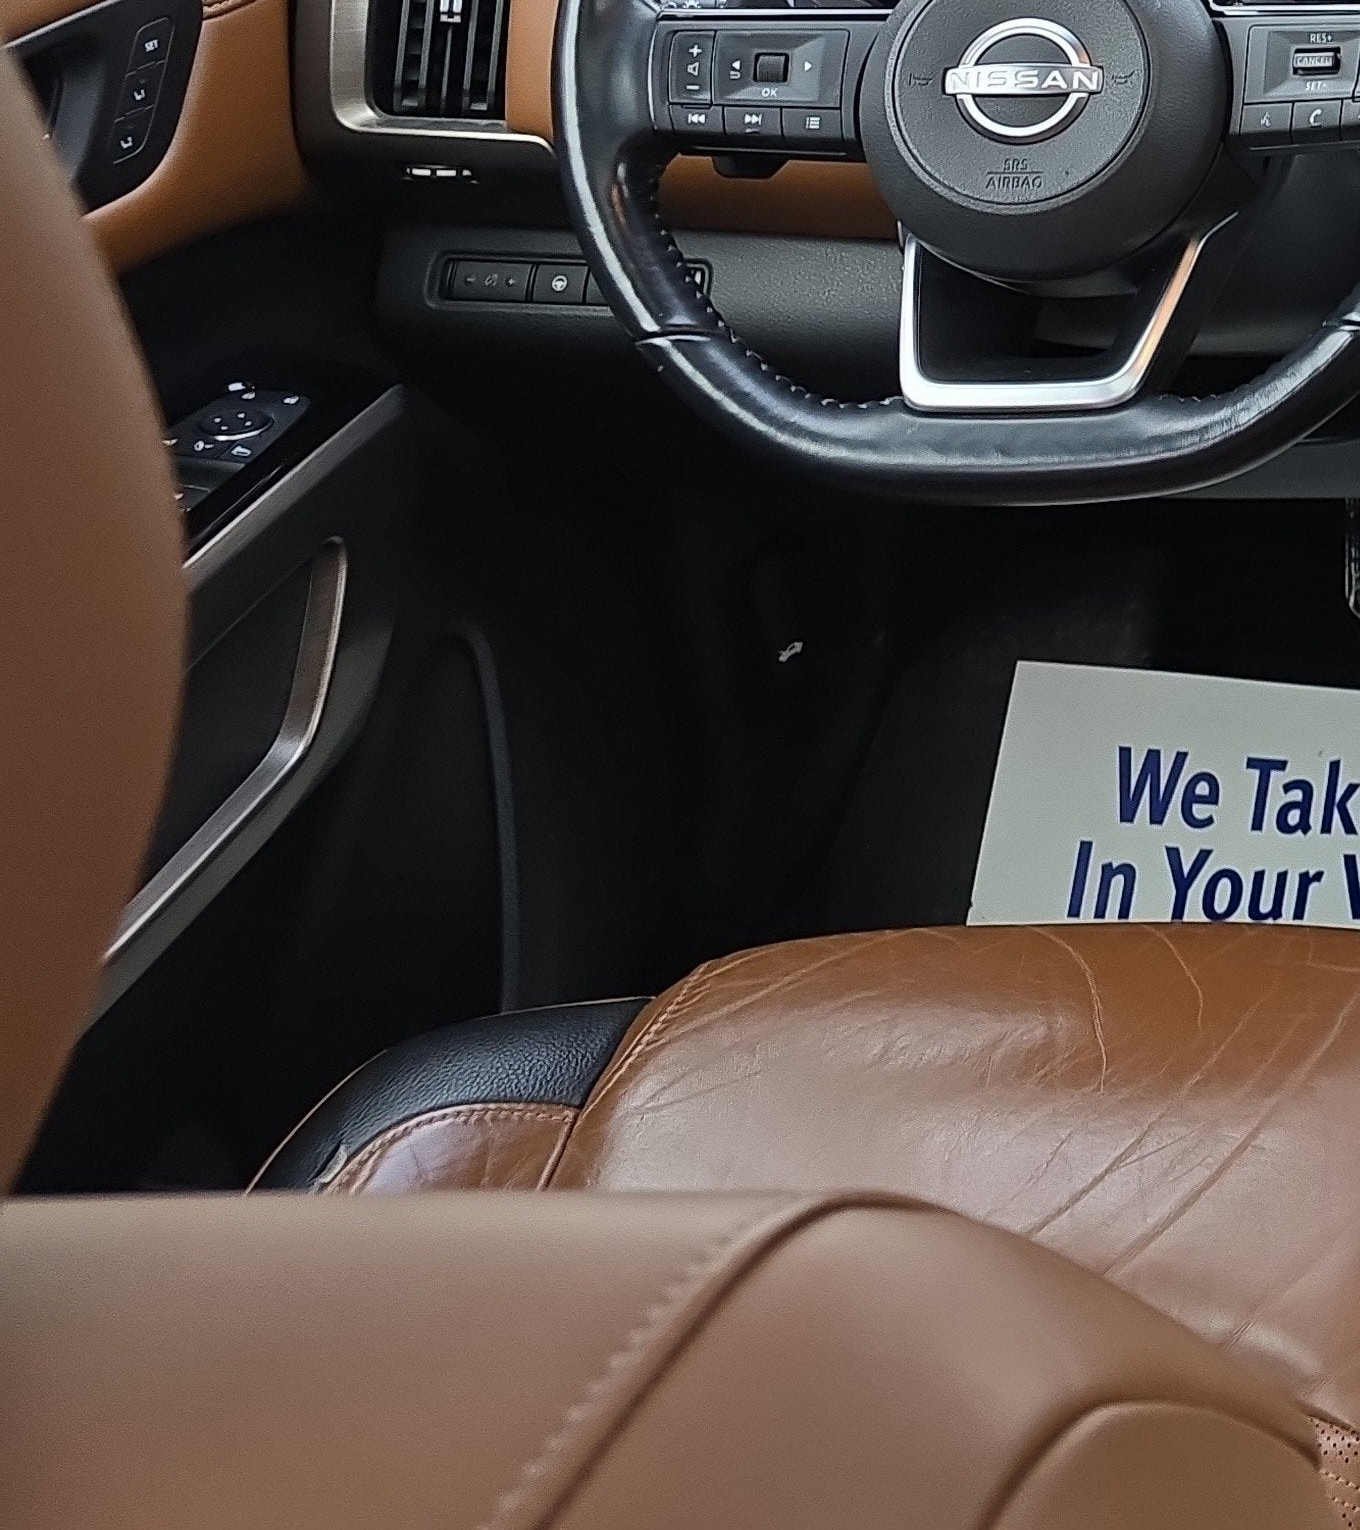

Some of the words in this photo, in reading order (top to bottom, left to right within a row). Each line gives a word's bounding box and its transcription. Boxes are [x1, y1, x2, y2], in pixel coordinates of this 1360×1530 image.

[1296, 56, 1330, 66] CANCEL
[950, 70, 1098, 91] NISSAN
[761, 88, 778, 98] OK
[1003, 158, 1028, 171] SRS
[985, 174, 1043, 190] AIRBAG
[1116, 745, 1220, 828] We
[1066, 841, 1139, 921] In
[1165, 846, 1324, 922] Your
